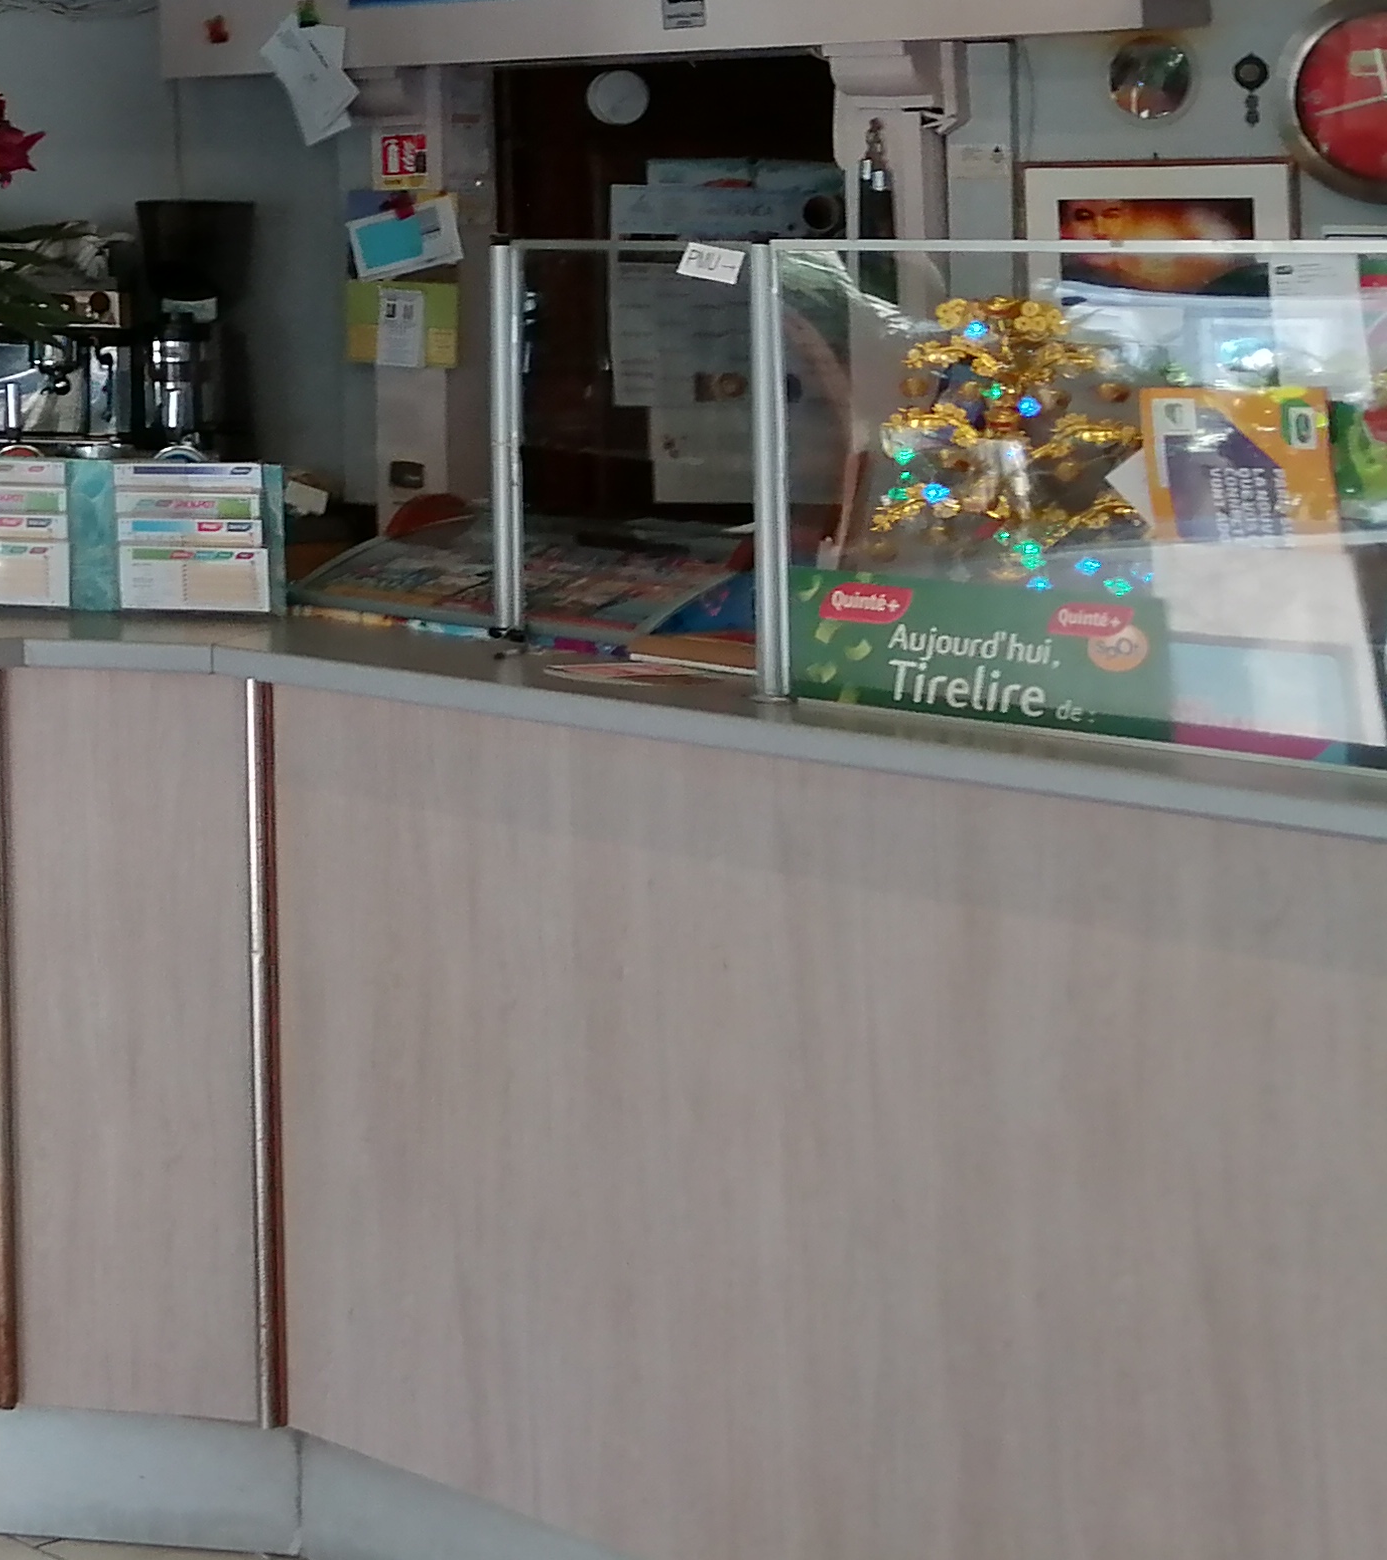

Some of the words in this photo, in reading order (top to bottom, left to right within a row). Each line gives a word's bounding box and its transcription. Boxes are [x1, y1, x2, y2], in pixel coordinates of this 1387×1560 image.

[830, 590, 901, 613] Quinté+
[1058, 608, 1121, 628] Quinté+
[888, 658, 1046, 718] Tirelire
